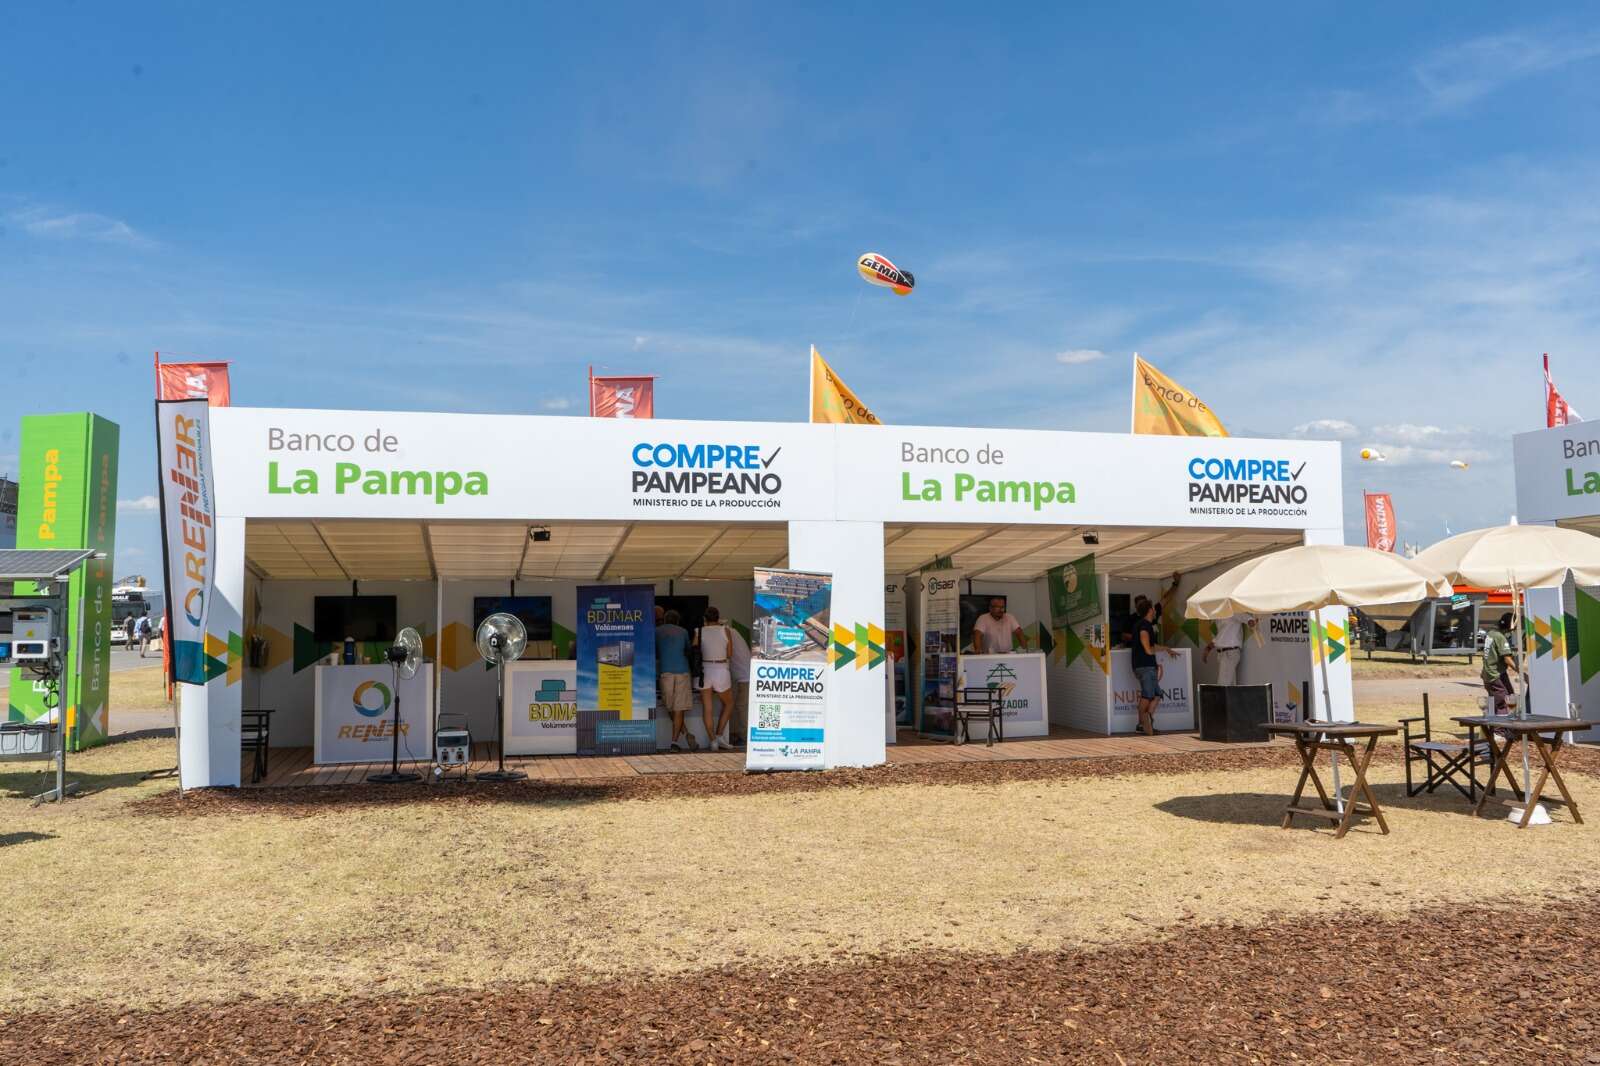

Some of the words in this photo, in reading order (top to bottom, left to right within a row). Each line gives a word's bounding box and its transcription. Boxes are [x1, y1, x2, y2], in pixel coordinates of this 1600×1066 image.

[267, 427, 355, 453] Banco
[363, 428, 399, 454] de
[632, 442, 761, 469] COMPRE
[901, 442, 970, 464] Banco
[976, 443, 1004, 465] de
[1188, 457, 1290, 481] COMPRE
[267, 462, 319, 494] La
[335, 462, 489, 504] Pampa
[632, 471, 782, 495] PAMPEANO
[902, 472, 942, 501] La
[954, 473, 1076, 511] Pampa
[1188, 482, 1308, 504] PAMPEANO
[1566, 467, 1600, 496] La
[38, 448, 62, 540] Pampa
[632, 498, 689, 507] MINISTERIO
[690, 499, 702, 508] DE
[705, 499, 717, 508] LA
[719, 498, 782, 508] PRODUCCIÓN
[1189, 507, 1234, 515] MINISTERIO
[1258, 506, 1308, 516] PRODUCCIÓN
[95, 584, 104, 614] de
[587, 609, 643, 624] BDIMAR
[595, 623, 634, 631] Volúmenes
[1270, 618, 1310, 633] PAMPE
[90, 623, 102, 691] Banco
[757, 666, 815, 681] COMPRE
[756, 681, 824, 694] PAMPEANO
